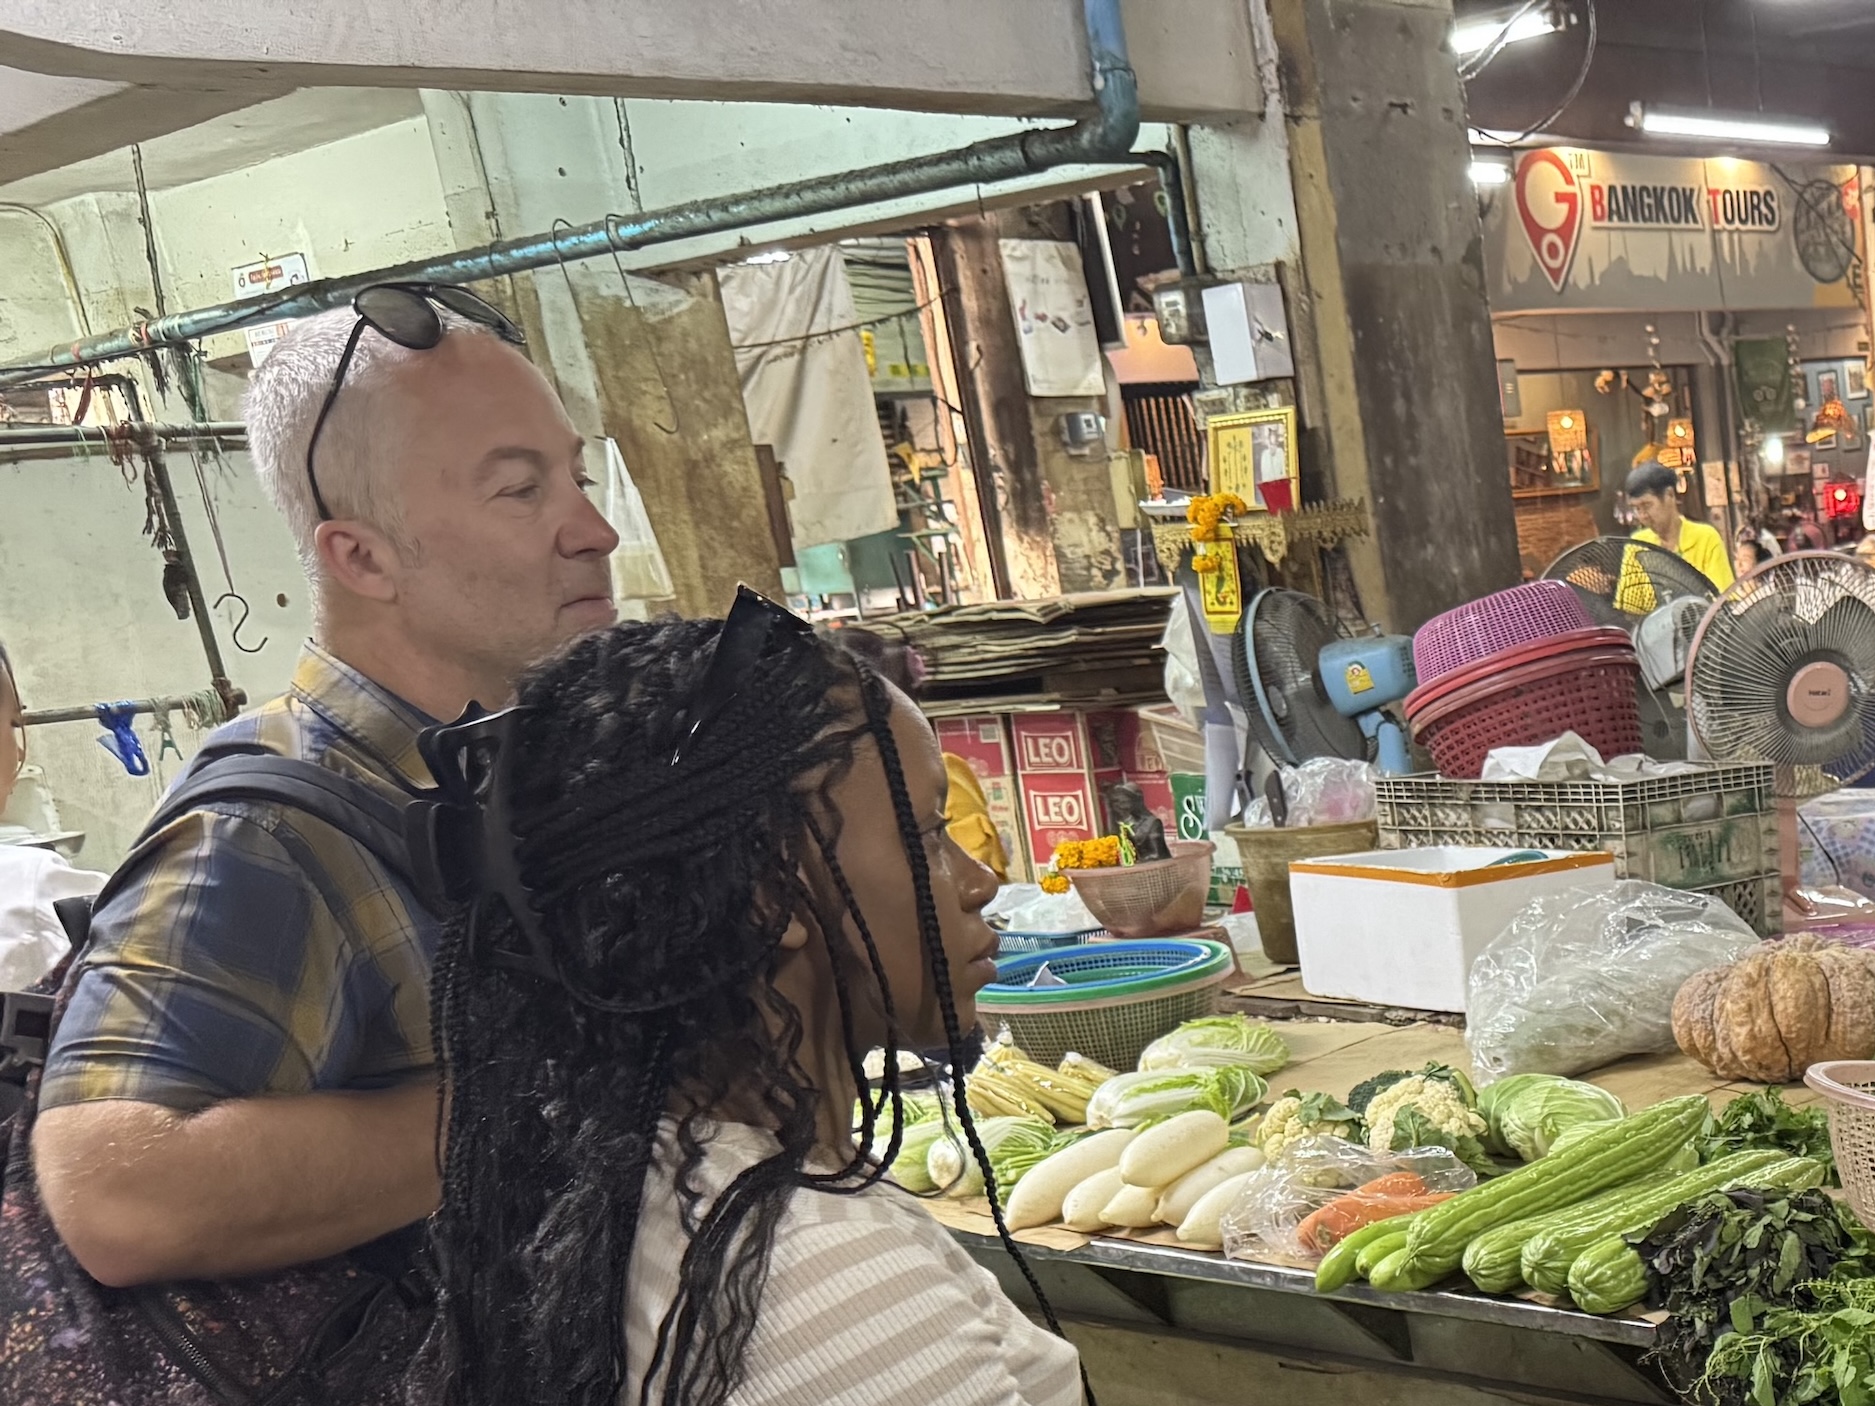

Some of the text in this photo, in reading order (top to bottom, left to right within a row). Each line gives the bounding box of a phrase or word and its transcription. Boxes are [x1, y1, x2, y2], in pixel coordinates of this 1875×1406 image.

[1590, 185, 1776, 226] BANGKOK TOURS
[1027, 737, 1070, 764] LEO
[1035, 796, 1080, 824] LEO
